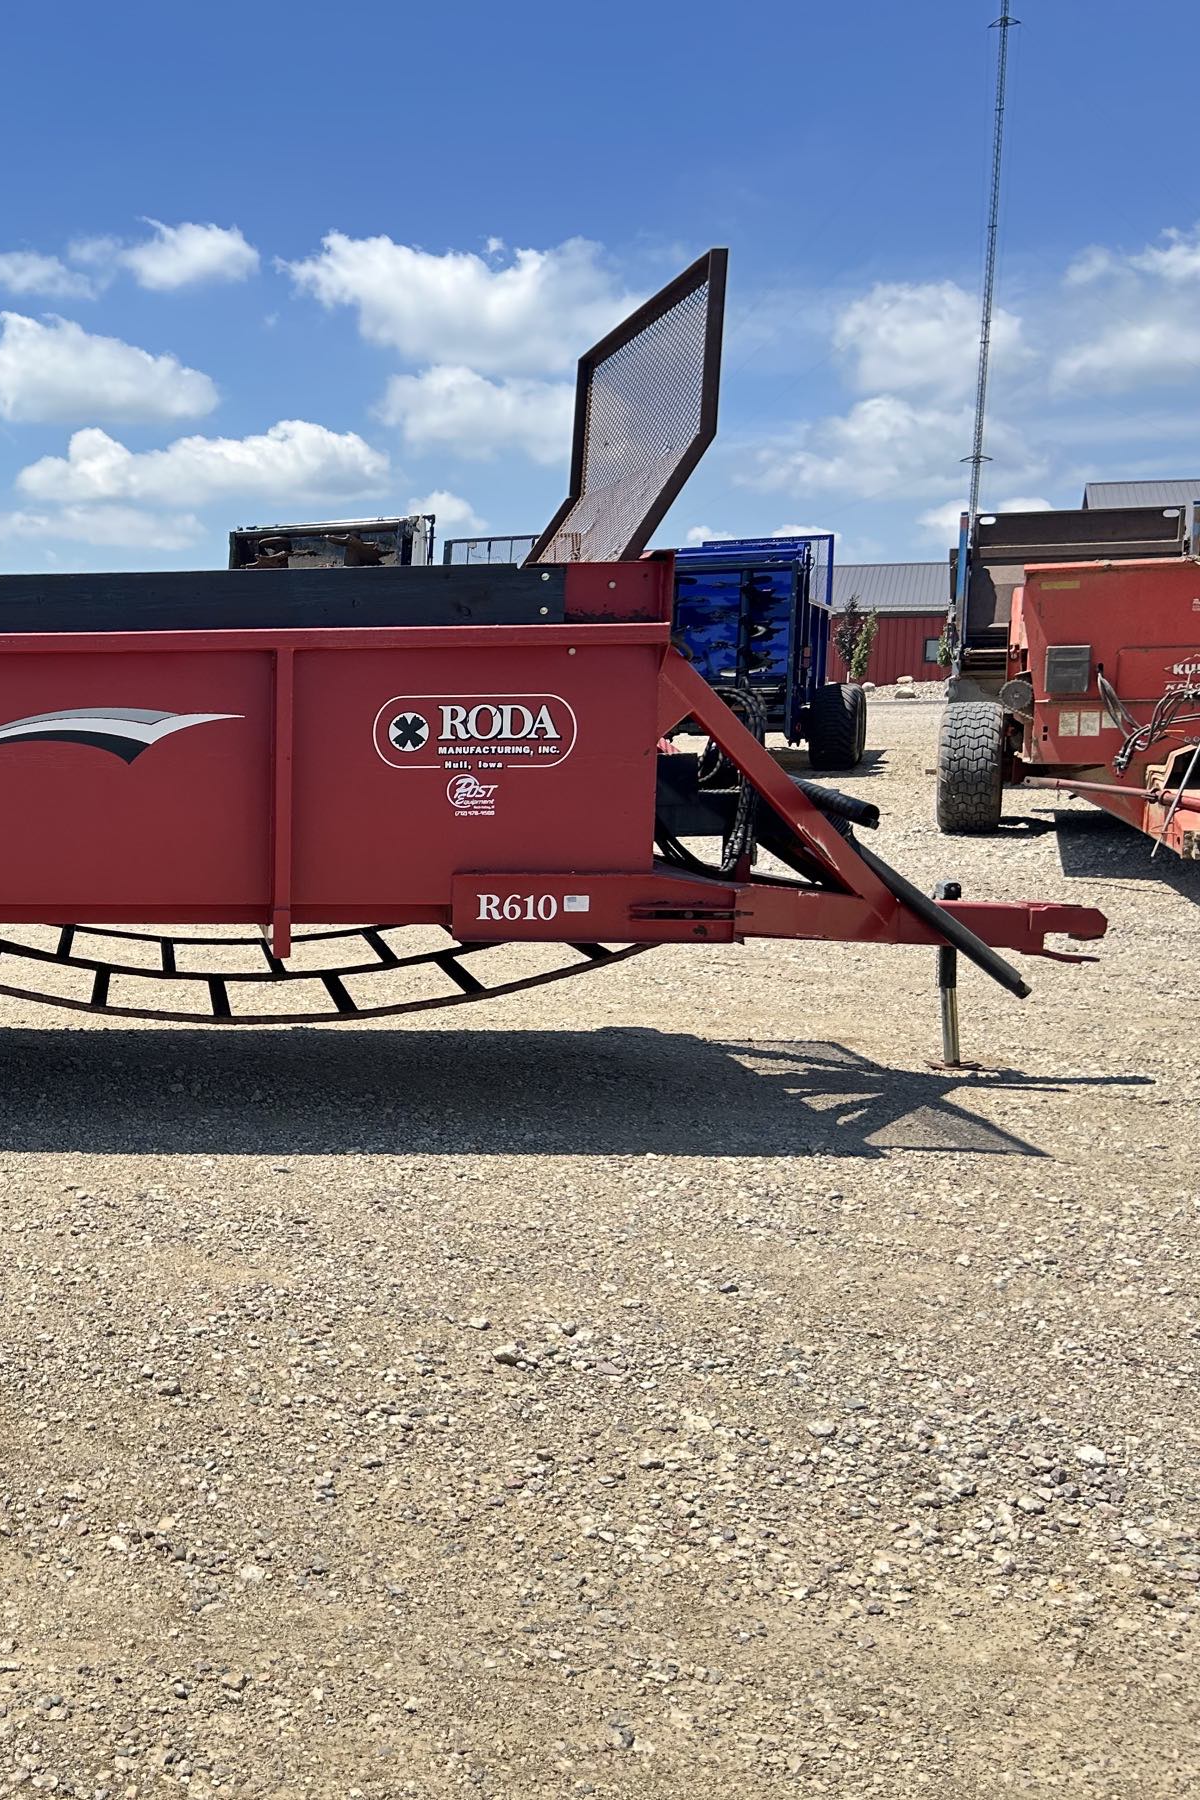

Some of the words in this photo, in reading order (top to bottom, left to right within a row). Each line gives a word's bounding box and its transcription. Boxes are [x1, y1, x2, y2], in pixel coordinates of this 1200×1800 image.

[437, 704, 561, 740] RODA
[438, 746, 534, 756] MANUFACTURING,
[538, 746, 560, 754] INC.
[444, 760, 472, 770] Hull,
[478, 760, 503, 769] Iowa
[476, 894, 558, 920] R610
